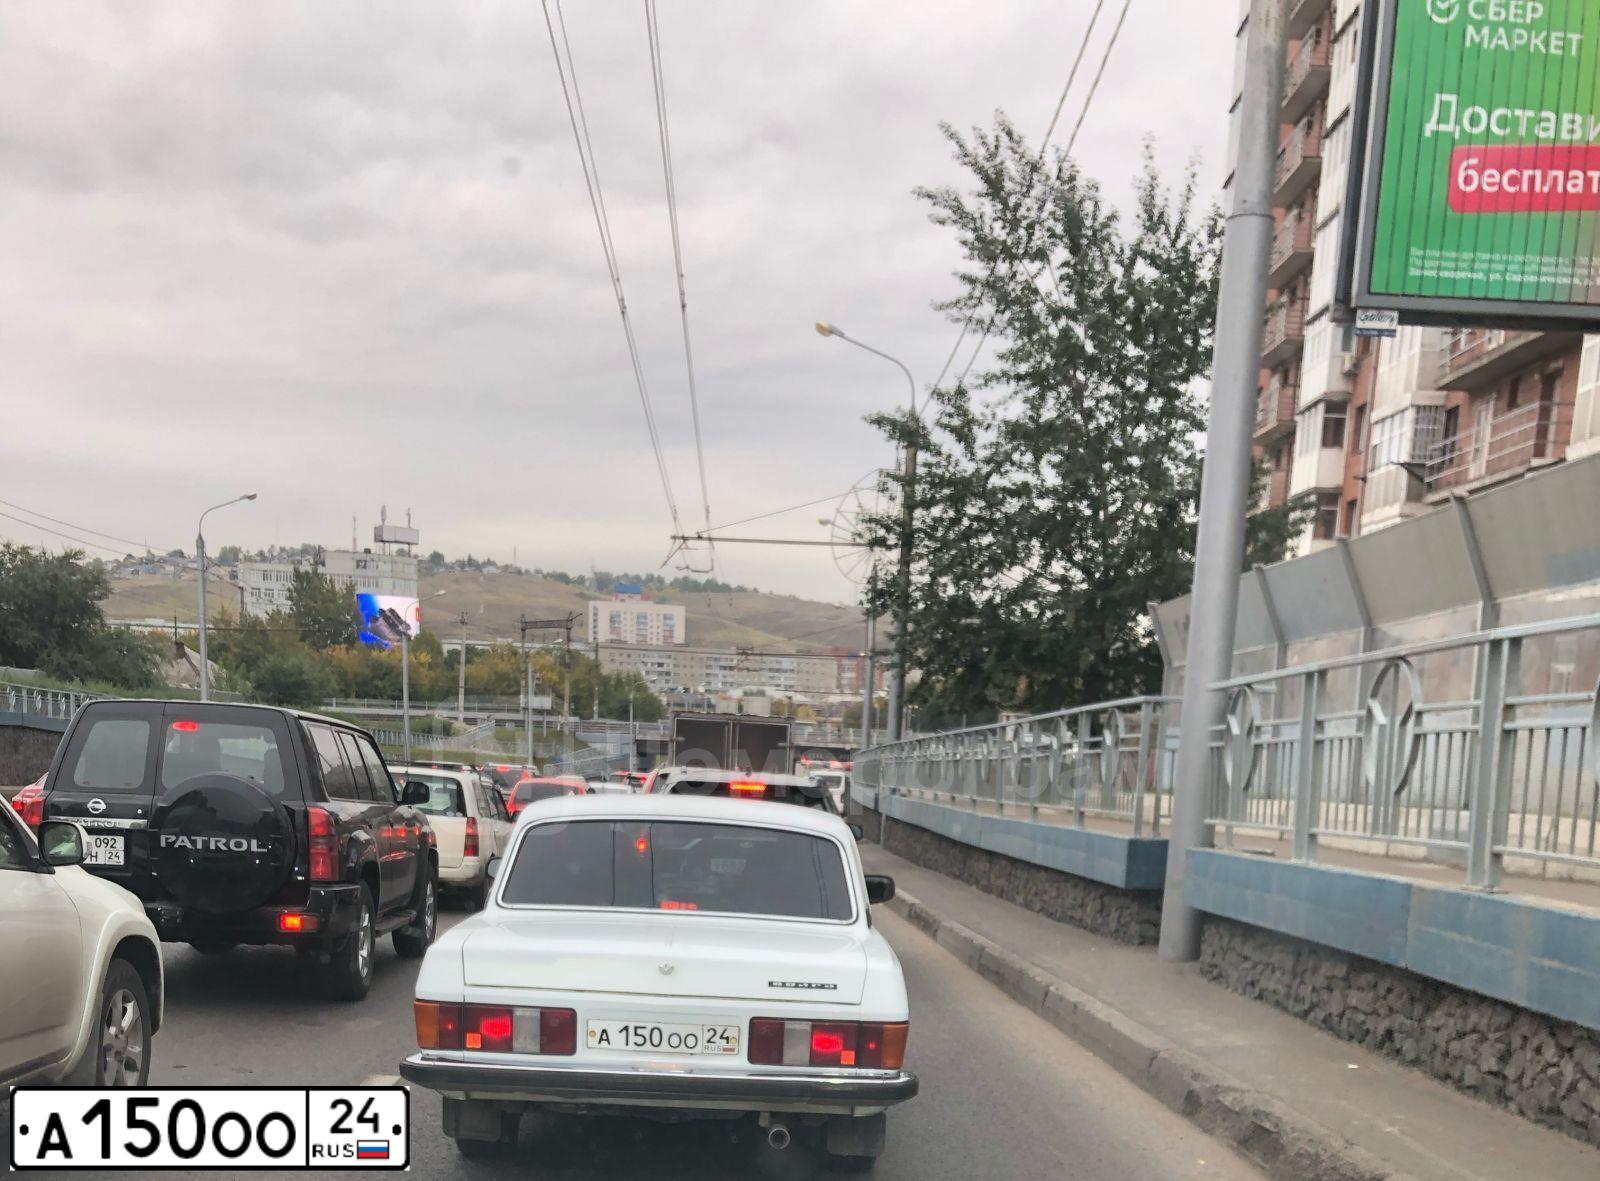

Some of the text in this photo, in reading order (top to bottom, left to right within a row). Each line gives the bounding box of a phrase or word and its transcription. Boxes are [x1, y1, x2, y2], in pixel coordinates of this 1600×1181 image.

[1467, 0, 1544, 24] СБЕР
[1464, 24, 1583, 56] МАРКЕТ
[94, 837, 117, 849] 092
[160, 834, 268, 852] PATROL
[108, 851, 120, 861] 24
[706, 1028, 730, 1044] 24
[704, 1044, 721, 1052] RUS
